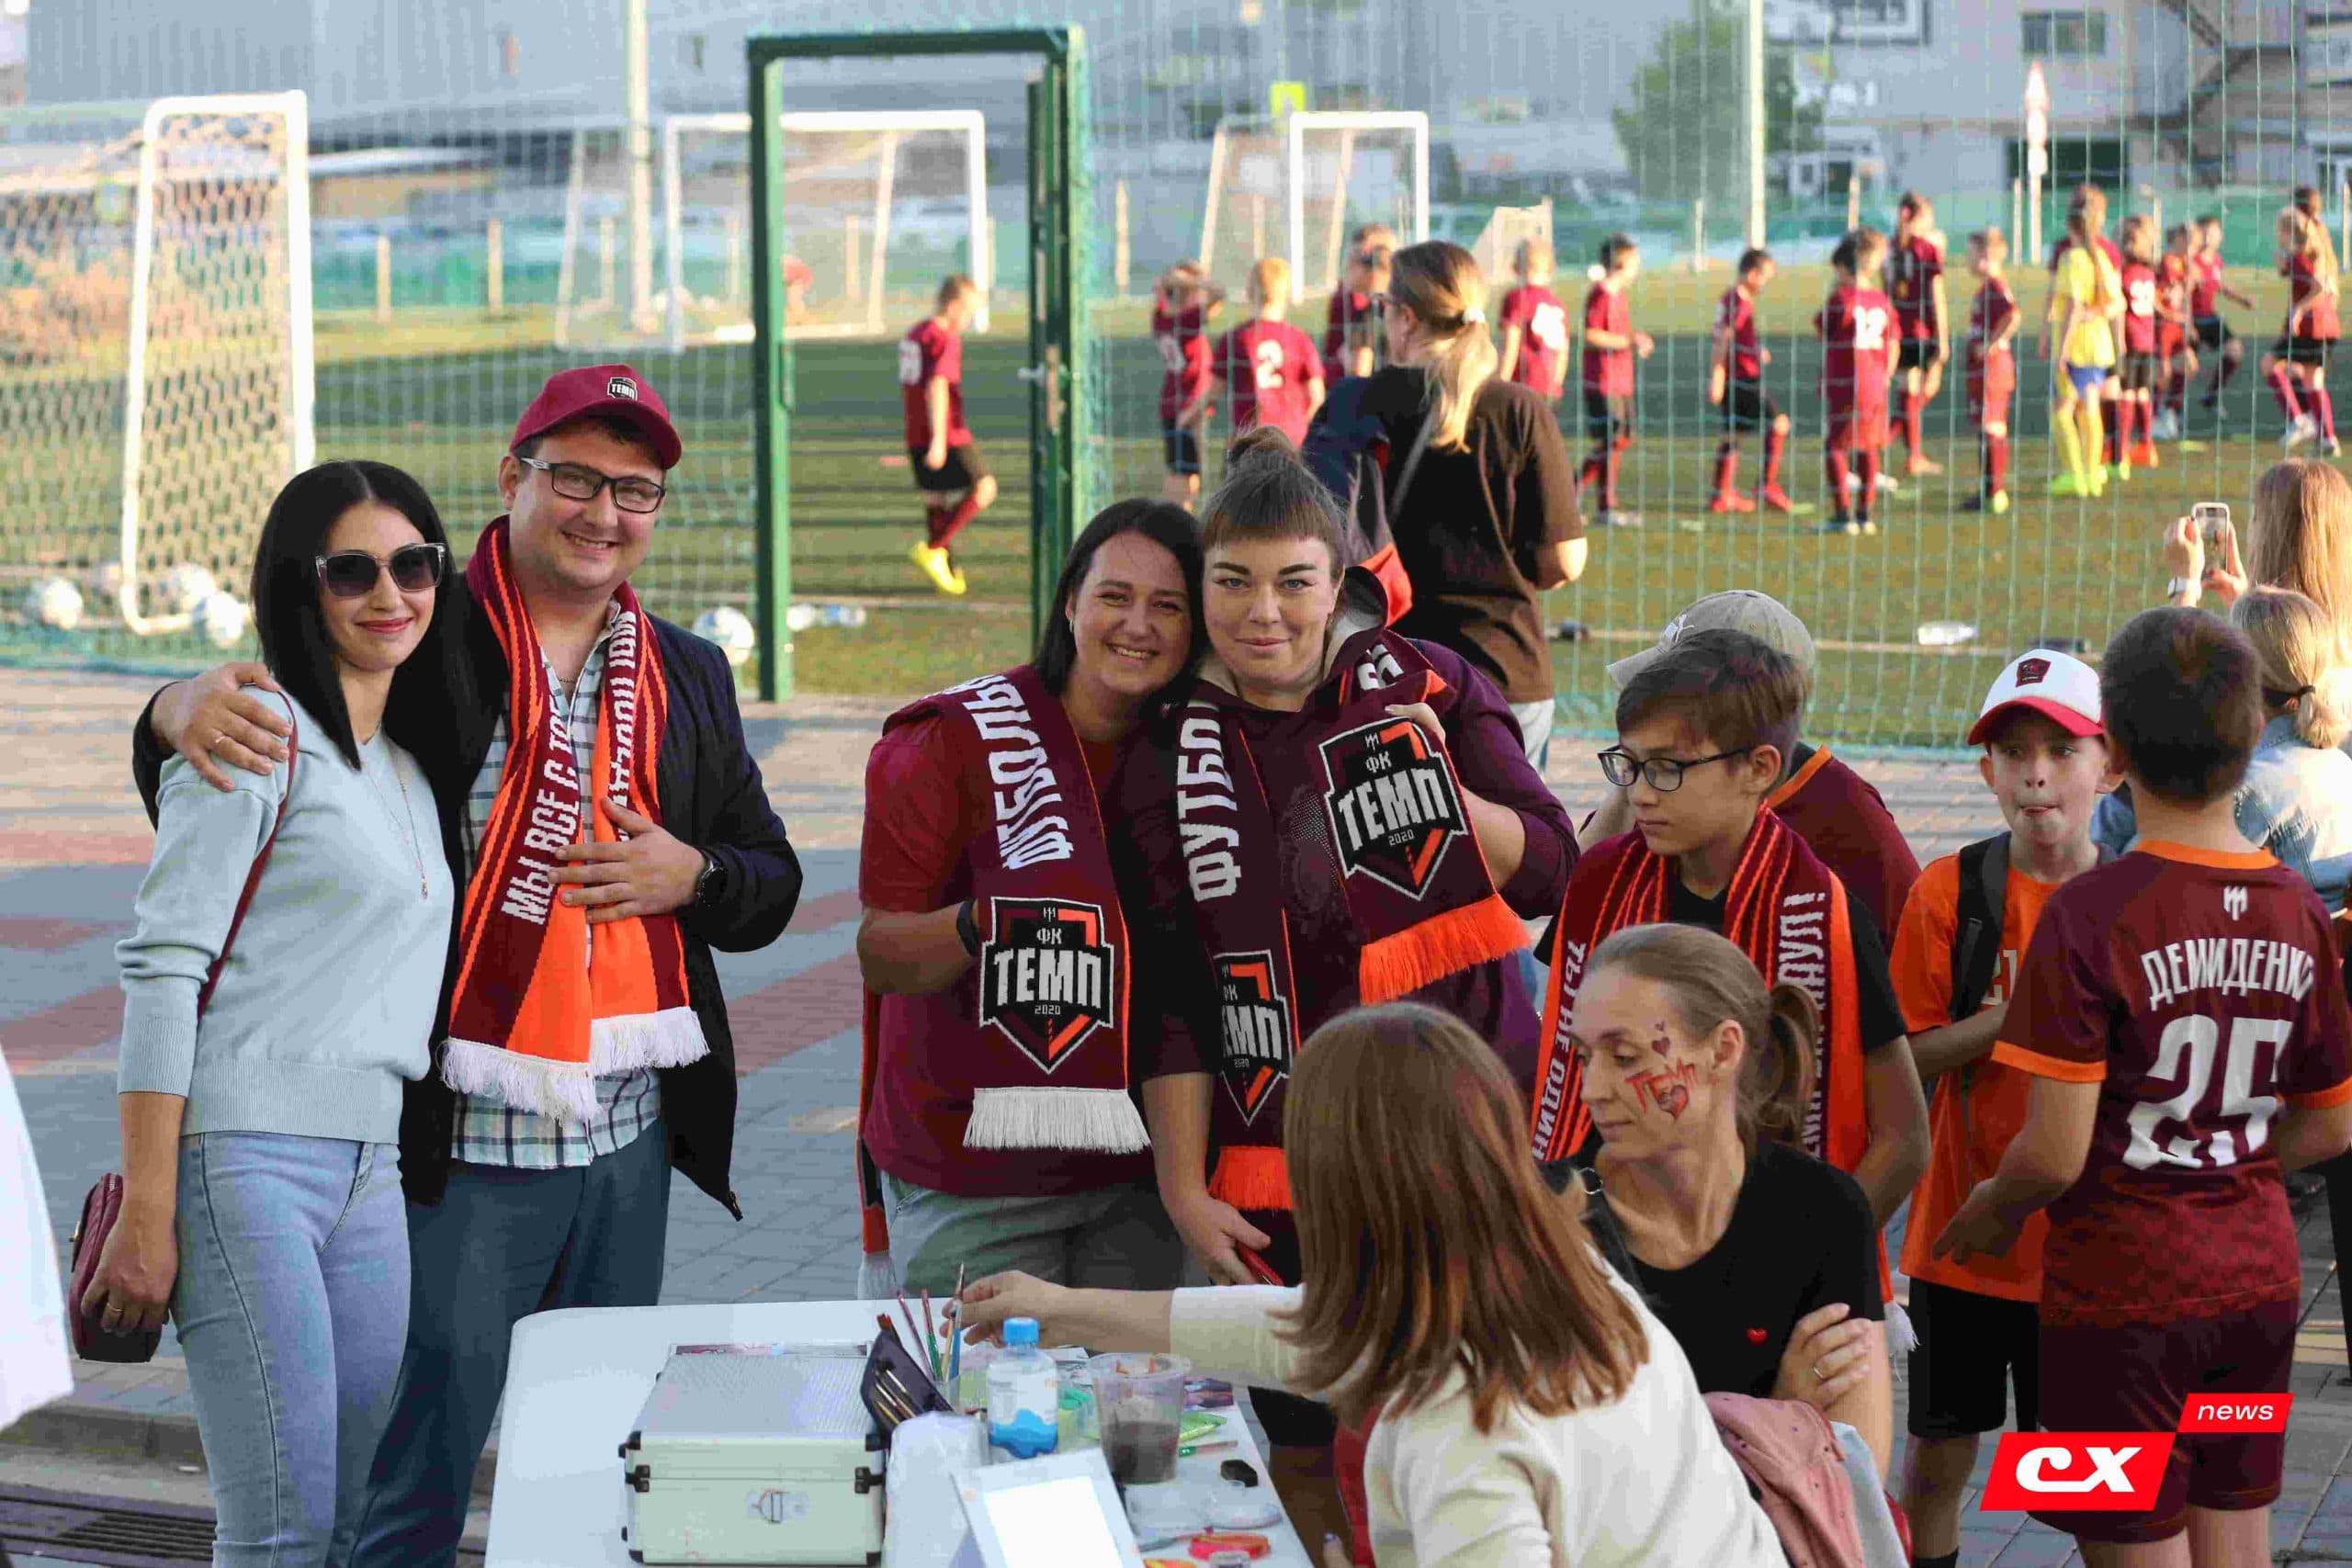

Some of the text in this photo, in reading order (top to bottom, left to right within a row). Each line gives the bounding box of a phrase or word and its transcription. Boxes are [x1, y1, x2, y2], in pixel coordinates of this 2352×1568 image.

[611, 383, 635, 400] ТЕМП
[1256, 339, 1283, 389] 2
[1365, 750, 1393, 773] ФК
[524, 789, 580, 852] ВСЕ
[1177, 700, 1242, 903] ФУТБО
[1337, 767, 1450, 852] ТЕМП
[1388, 829, 1416, 846] 2020
[501, 856, 556, 925] МЫ
[1036, 928, 1062, 944] ФК
[994, 947, 1102, 1009] ТЕМП
[1035, 1005, 1061, 1015] 2020
[1531, 1056, 1566, 1161] ОДИН
[2123, 1014, 2294, 1171] 25
